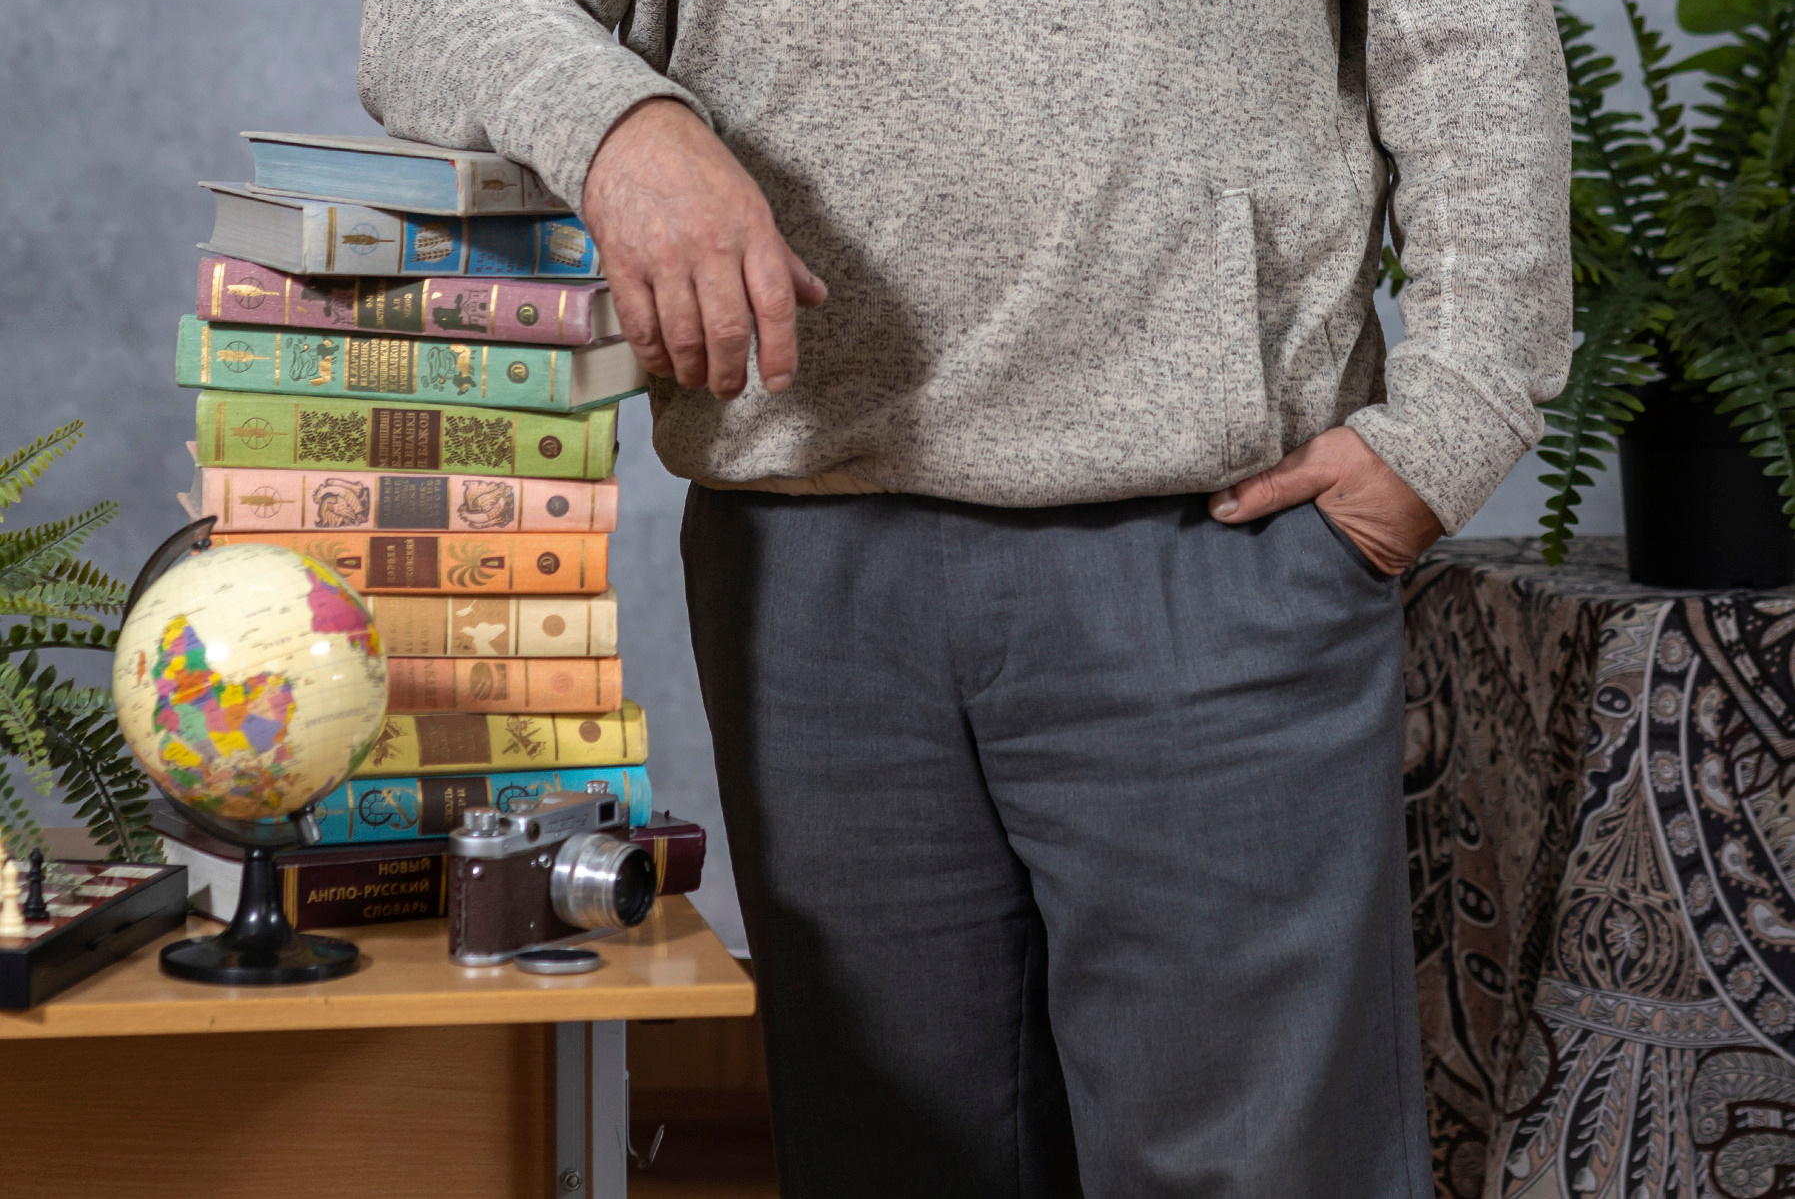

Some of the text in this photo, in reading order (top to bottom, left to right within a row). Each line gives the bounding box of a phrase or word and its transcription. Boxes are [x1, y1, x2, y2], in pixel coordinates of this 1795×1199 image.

[403, 292, 413, 318] ЧЕХОВ
[378, 858, 431, 876] НОВЫЙ
[307, 878, 429, 904] АНГЛО-РУССКИЙ
[363, 901, 427, 919] СЛОВАРЬ
